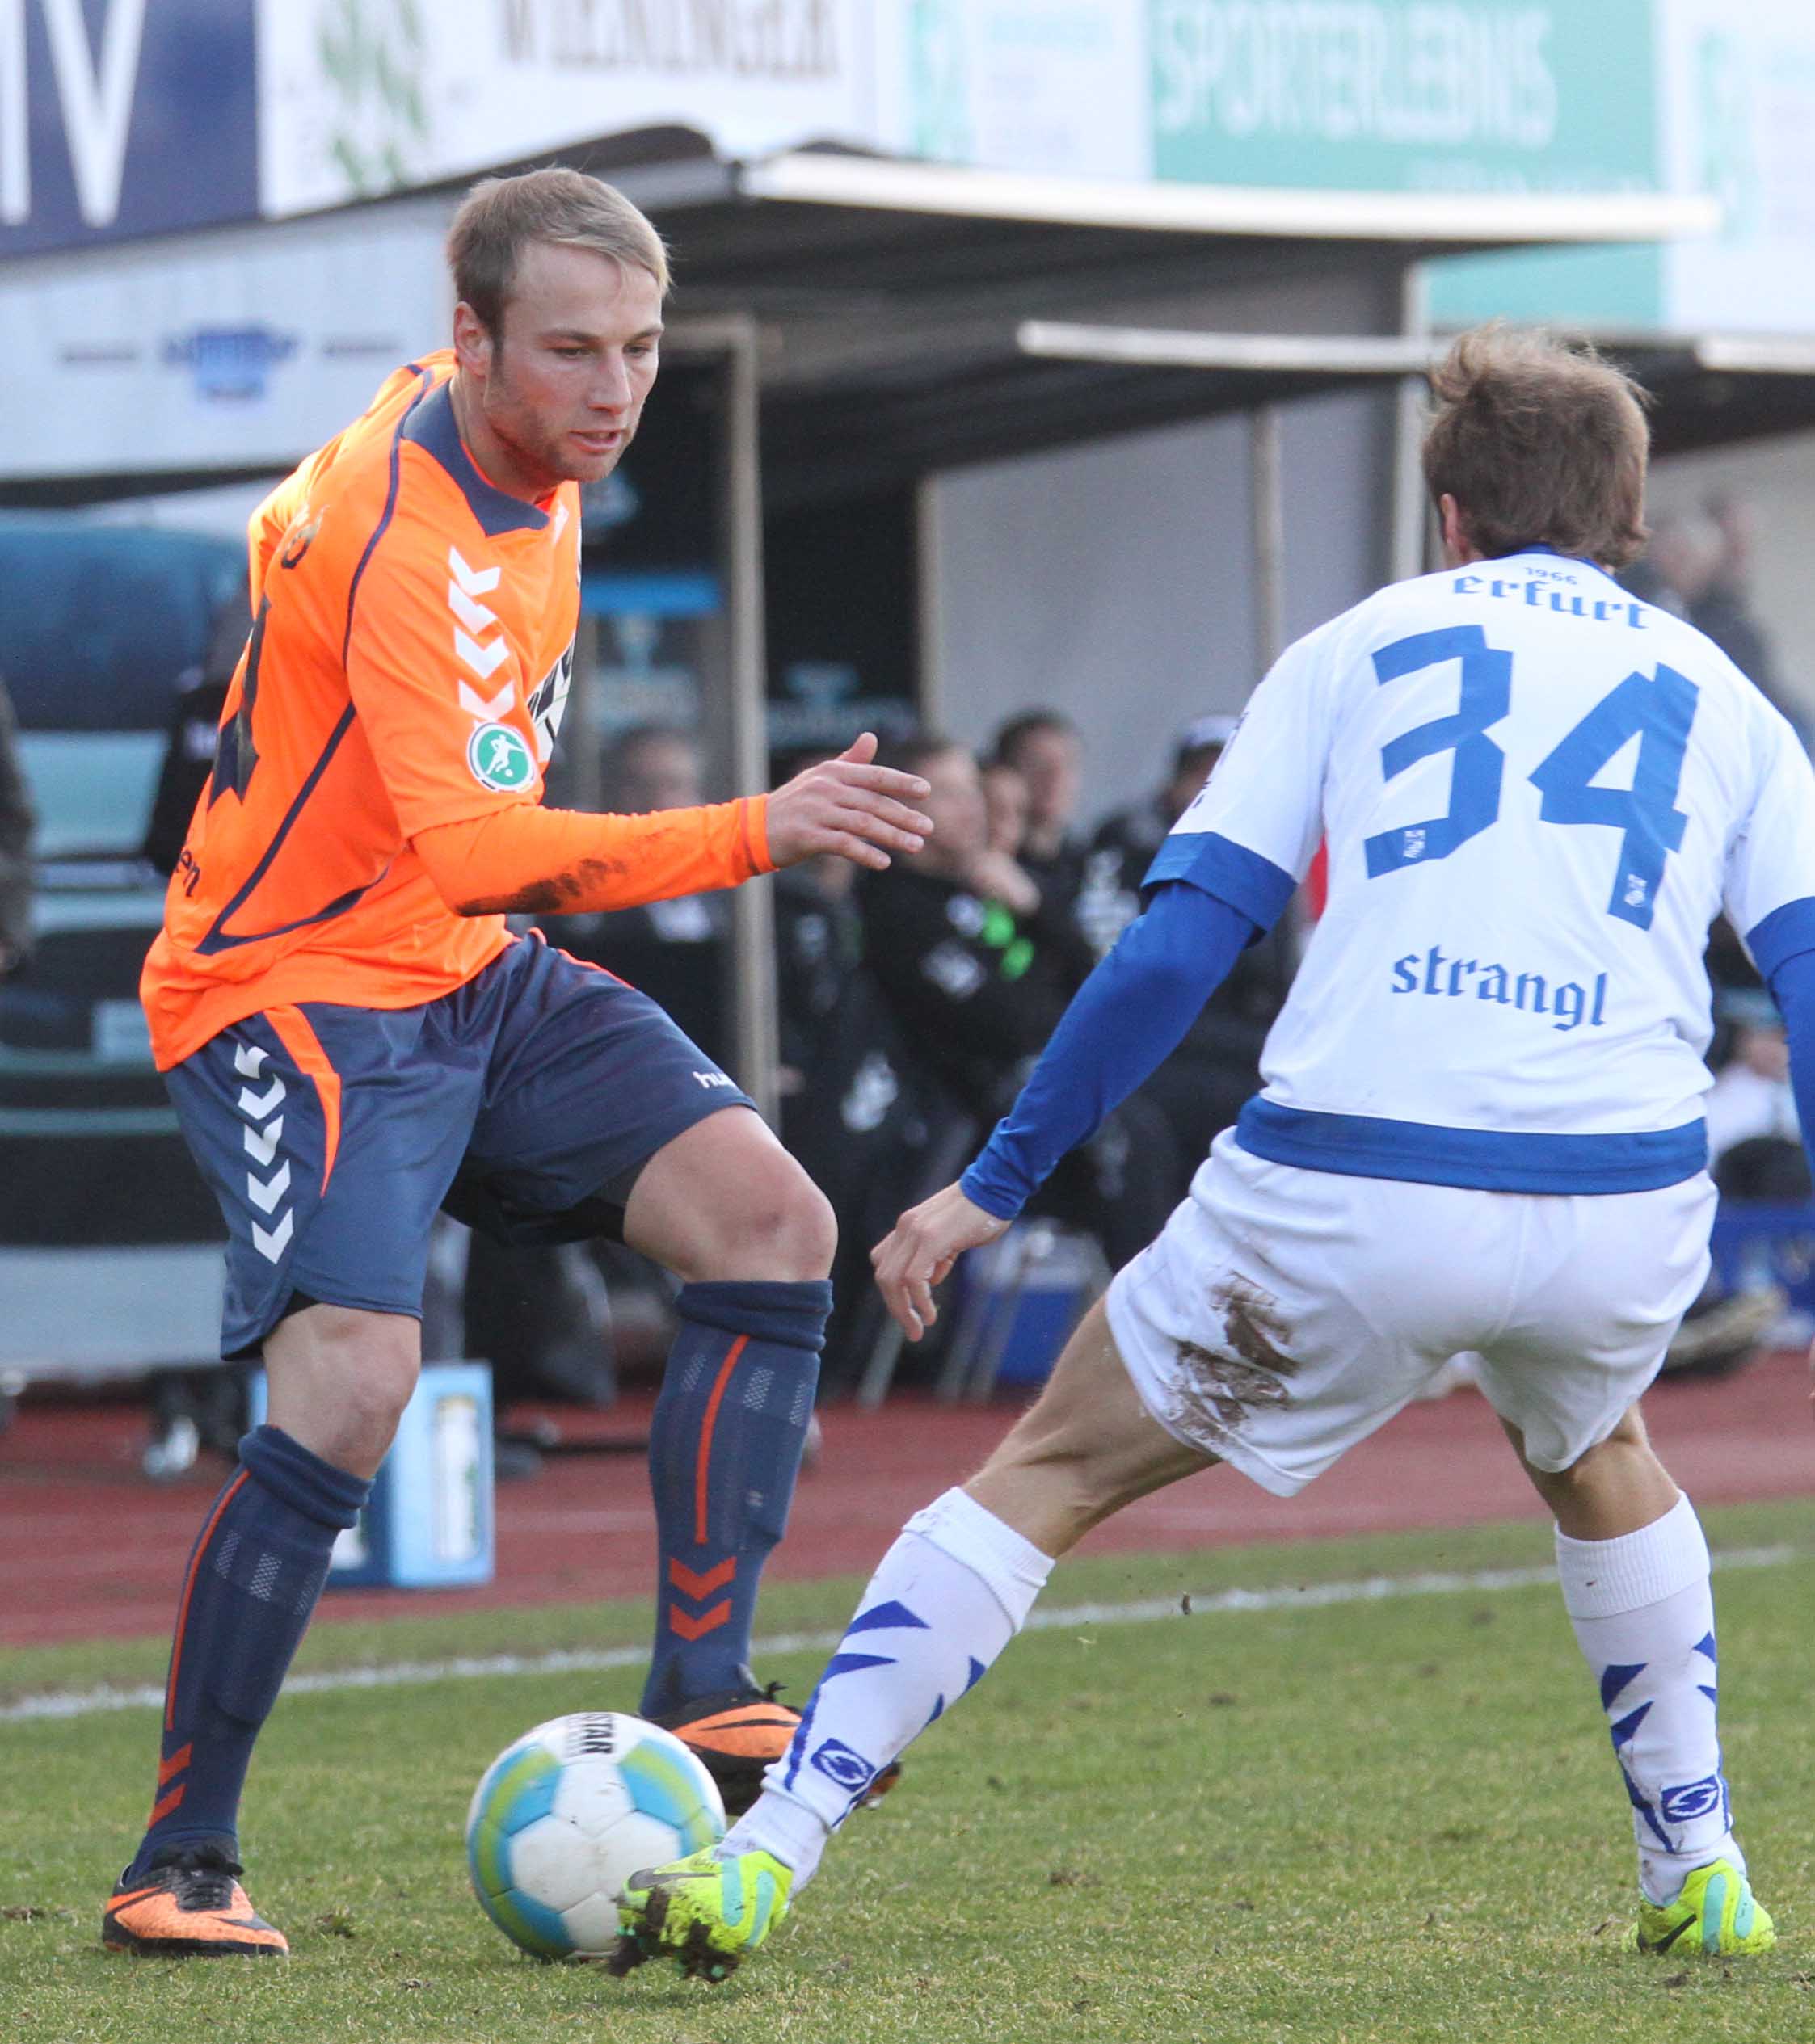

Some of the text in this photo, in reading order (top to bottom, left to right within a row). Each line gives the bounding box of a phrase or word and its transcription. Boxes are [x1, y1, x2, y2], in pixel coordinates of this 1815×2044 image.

[1452, 575, 1649, 629] erfurt
[1524, 567, 1579, 585] 1966
[1363, 624, 1699, 932] 34
[1391, 944, 1608, 1032] strangl
